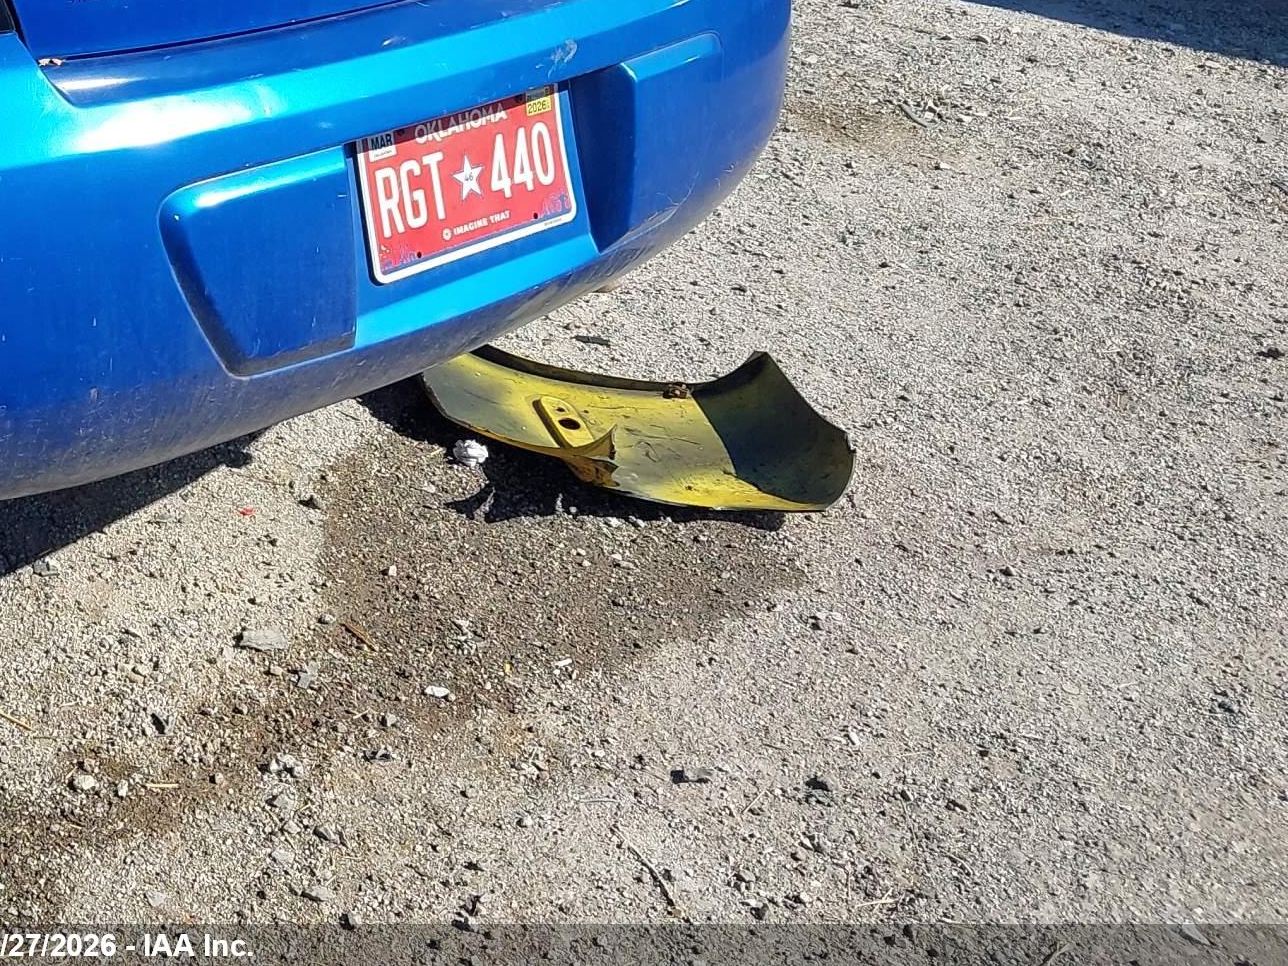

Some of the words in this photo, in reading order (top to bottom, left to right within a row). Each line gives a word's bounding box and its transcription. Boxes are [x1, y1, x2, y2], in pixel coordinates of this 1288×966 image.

[527, 98, 547, 115] 2026
[414, 103, 508, 144] OKLAHOMA
[370, 133, 393, 152] MAR
[375, 151, 446, 239] RGT
[490, 121, 556, 199] 440
[453, 217, 489, 236] IMAGINE
[489, 210, 511, 225] THAT
